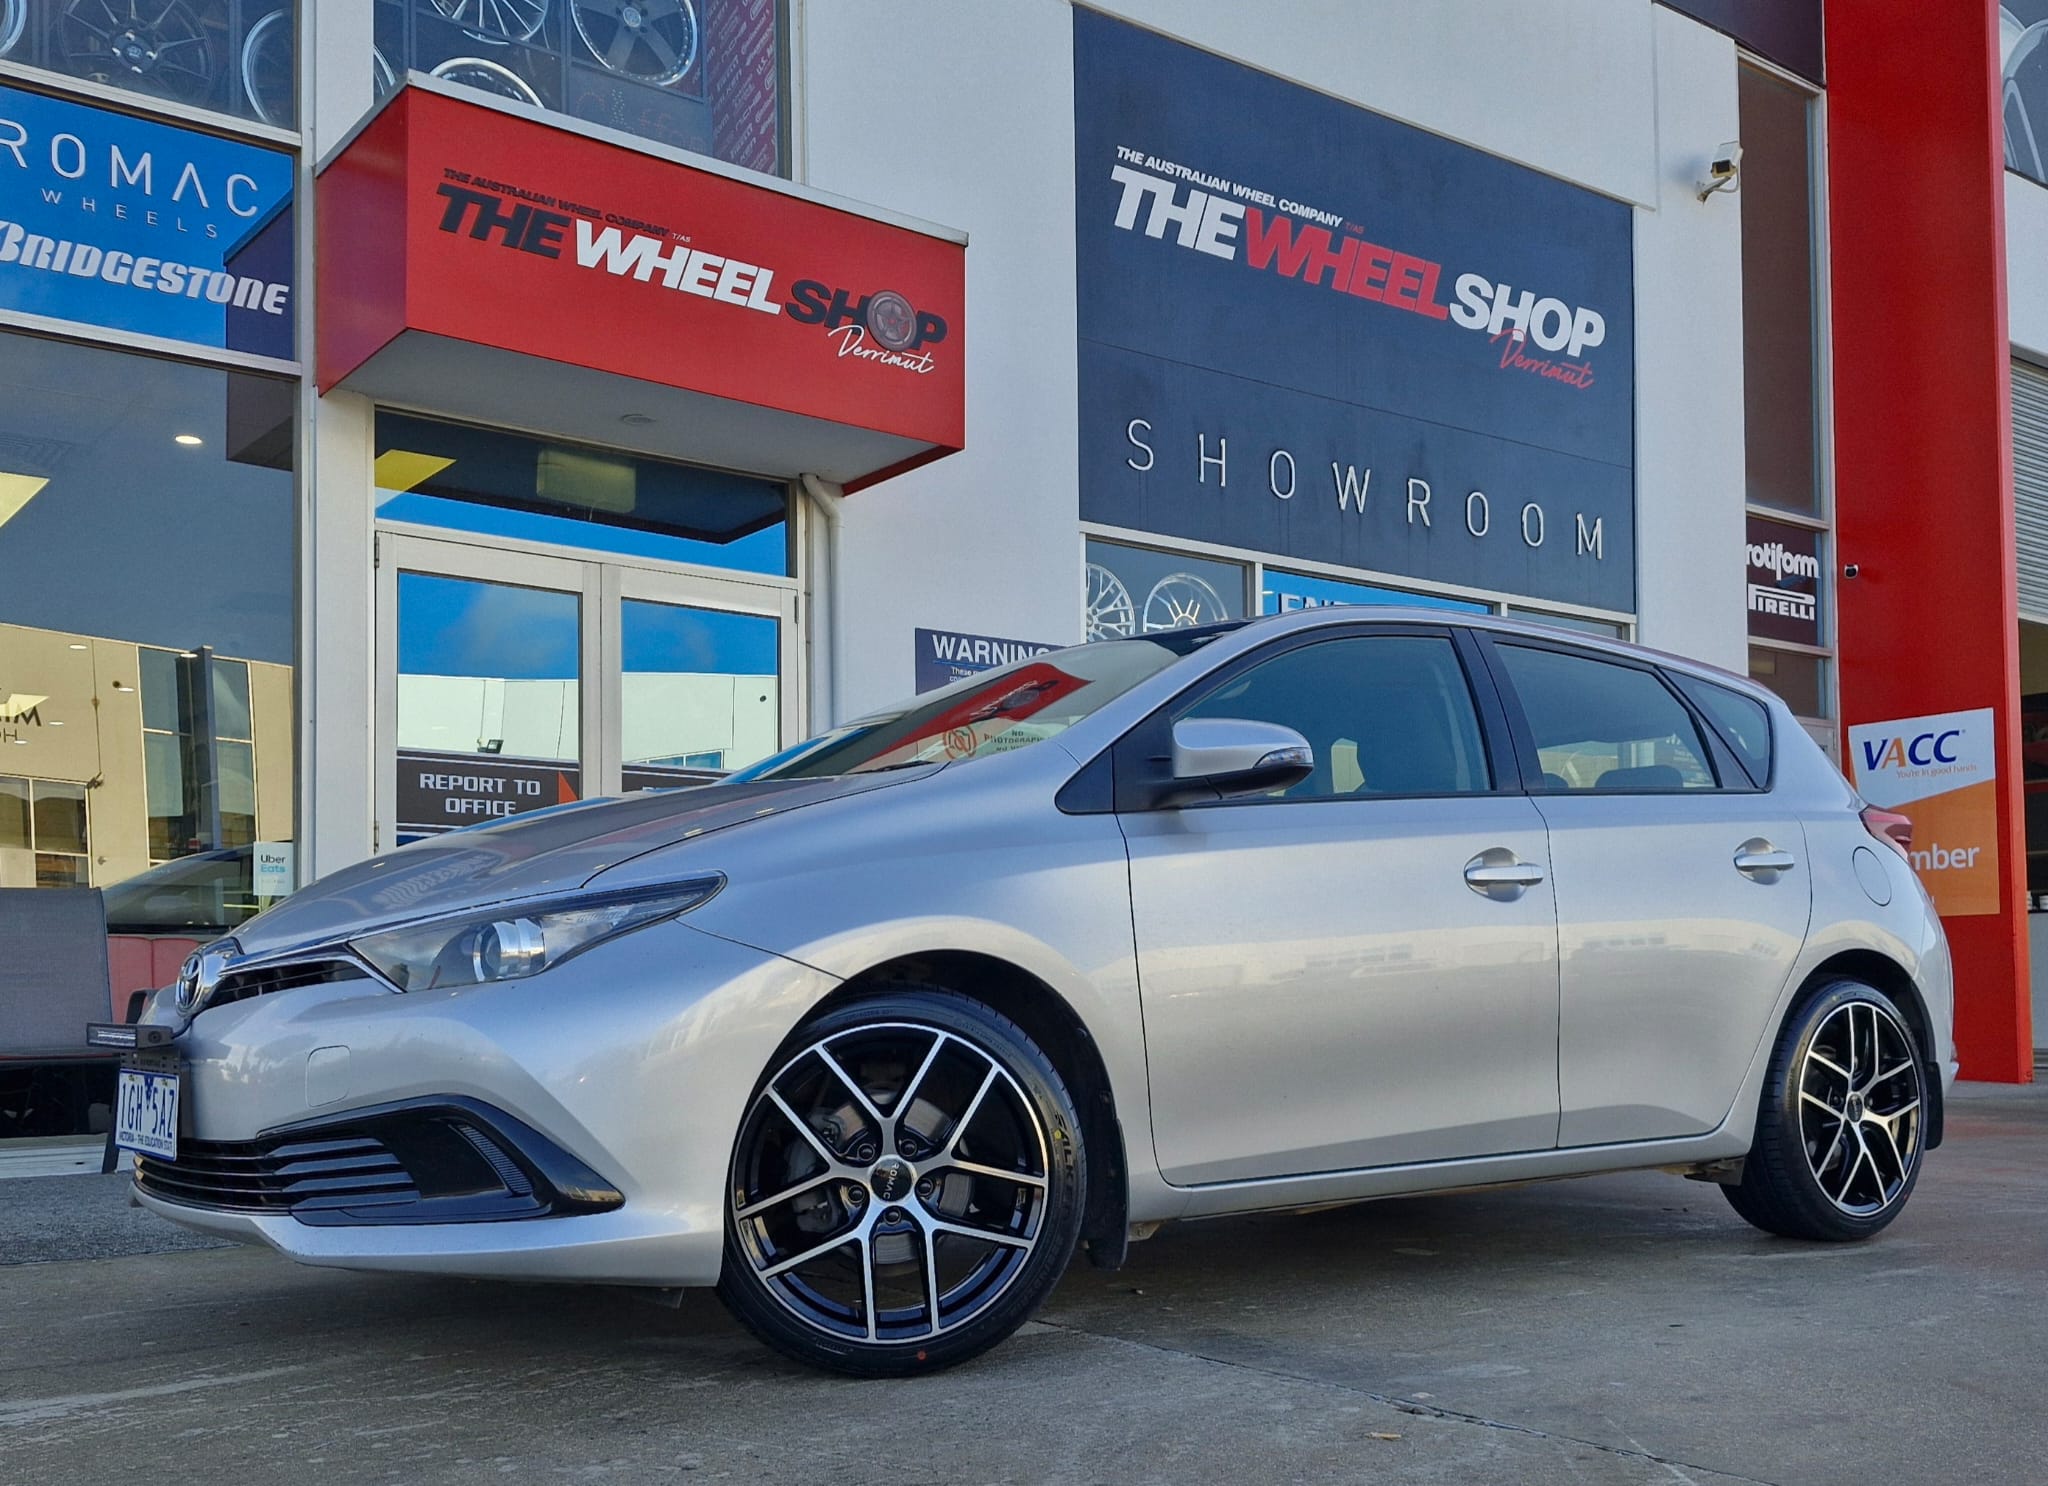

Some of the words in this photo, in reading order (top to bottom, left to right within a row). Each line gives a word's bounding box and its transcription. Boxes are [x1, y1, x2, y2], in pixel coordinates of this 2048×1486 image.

[444, 168, 472, 185] THE
[471, 177, 556, 207] AUSTRALIAN
[558, 200, 603, 220] WHEEL
[605, 213, 670, 237] COMPANY
[672, 233, 692, 243] T/AS
[1116, 145, 1145, 165] THE
[1145, 155, 1231, 193] AUSTRALIAN
[1232, 183, 1277, 208] WHEEL
[1278, 198, 1344, 228] COMPANY
[41, 187, 218, 239] WHEELS
[0, 220, 290, 315] BRIDGESTONE
[436, 182, 572, 260] THE
[575, 218, 782, 316] WHEEL
[1110, 164, 1247, 261] THE
[1246, 206, 1450, 321] WHEEL
[1449, 273, 1606, 358] SHOP
[827, 324, 935, 374] Derrimut
[1488, 328, 1595, 389] Derrimut
[1126, 418, 1604, 561] SHOWROOM
[1746, 542, 1819, 581] rotiform
[1747, 583, 1816, 621] PIRELLI
[984, 732, 1050, 744] PHOTOGRAP
[1011, 729, 1024, 737] NO
[1863, 730, 1960, 771] VACC
[419, 772, 507, 794] REPORT
[513, 778, 541, 796] TO
[445, 798, 517, 817] OFFICE
[260, 854, 287, 864] Uber
[260, 864, 287, 873] Eats
[1910, 843, 1980, 871] mber
